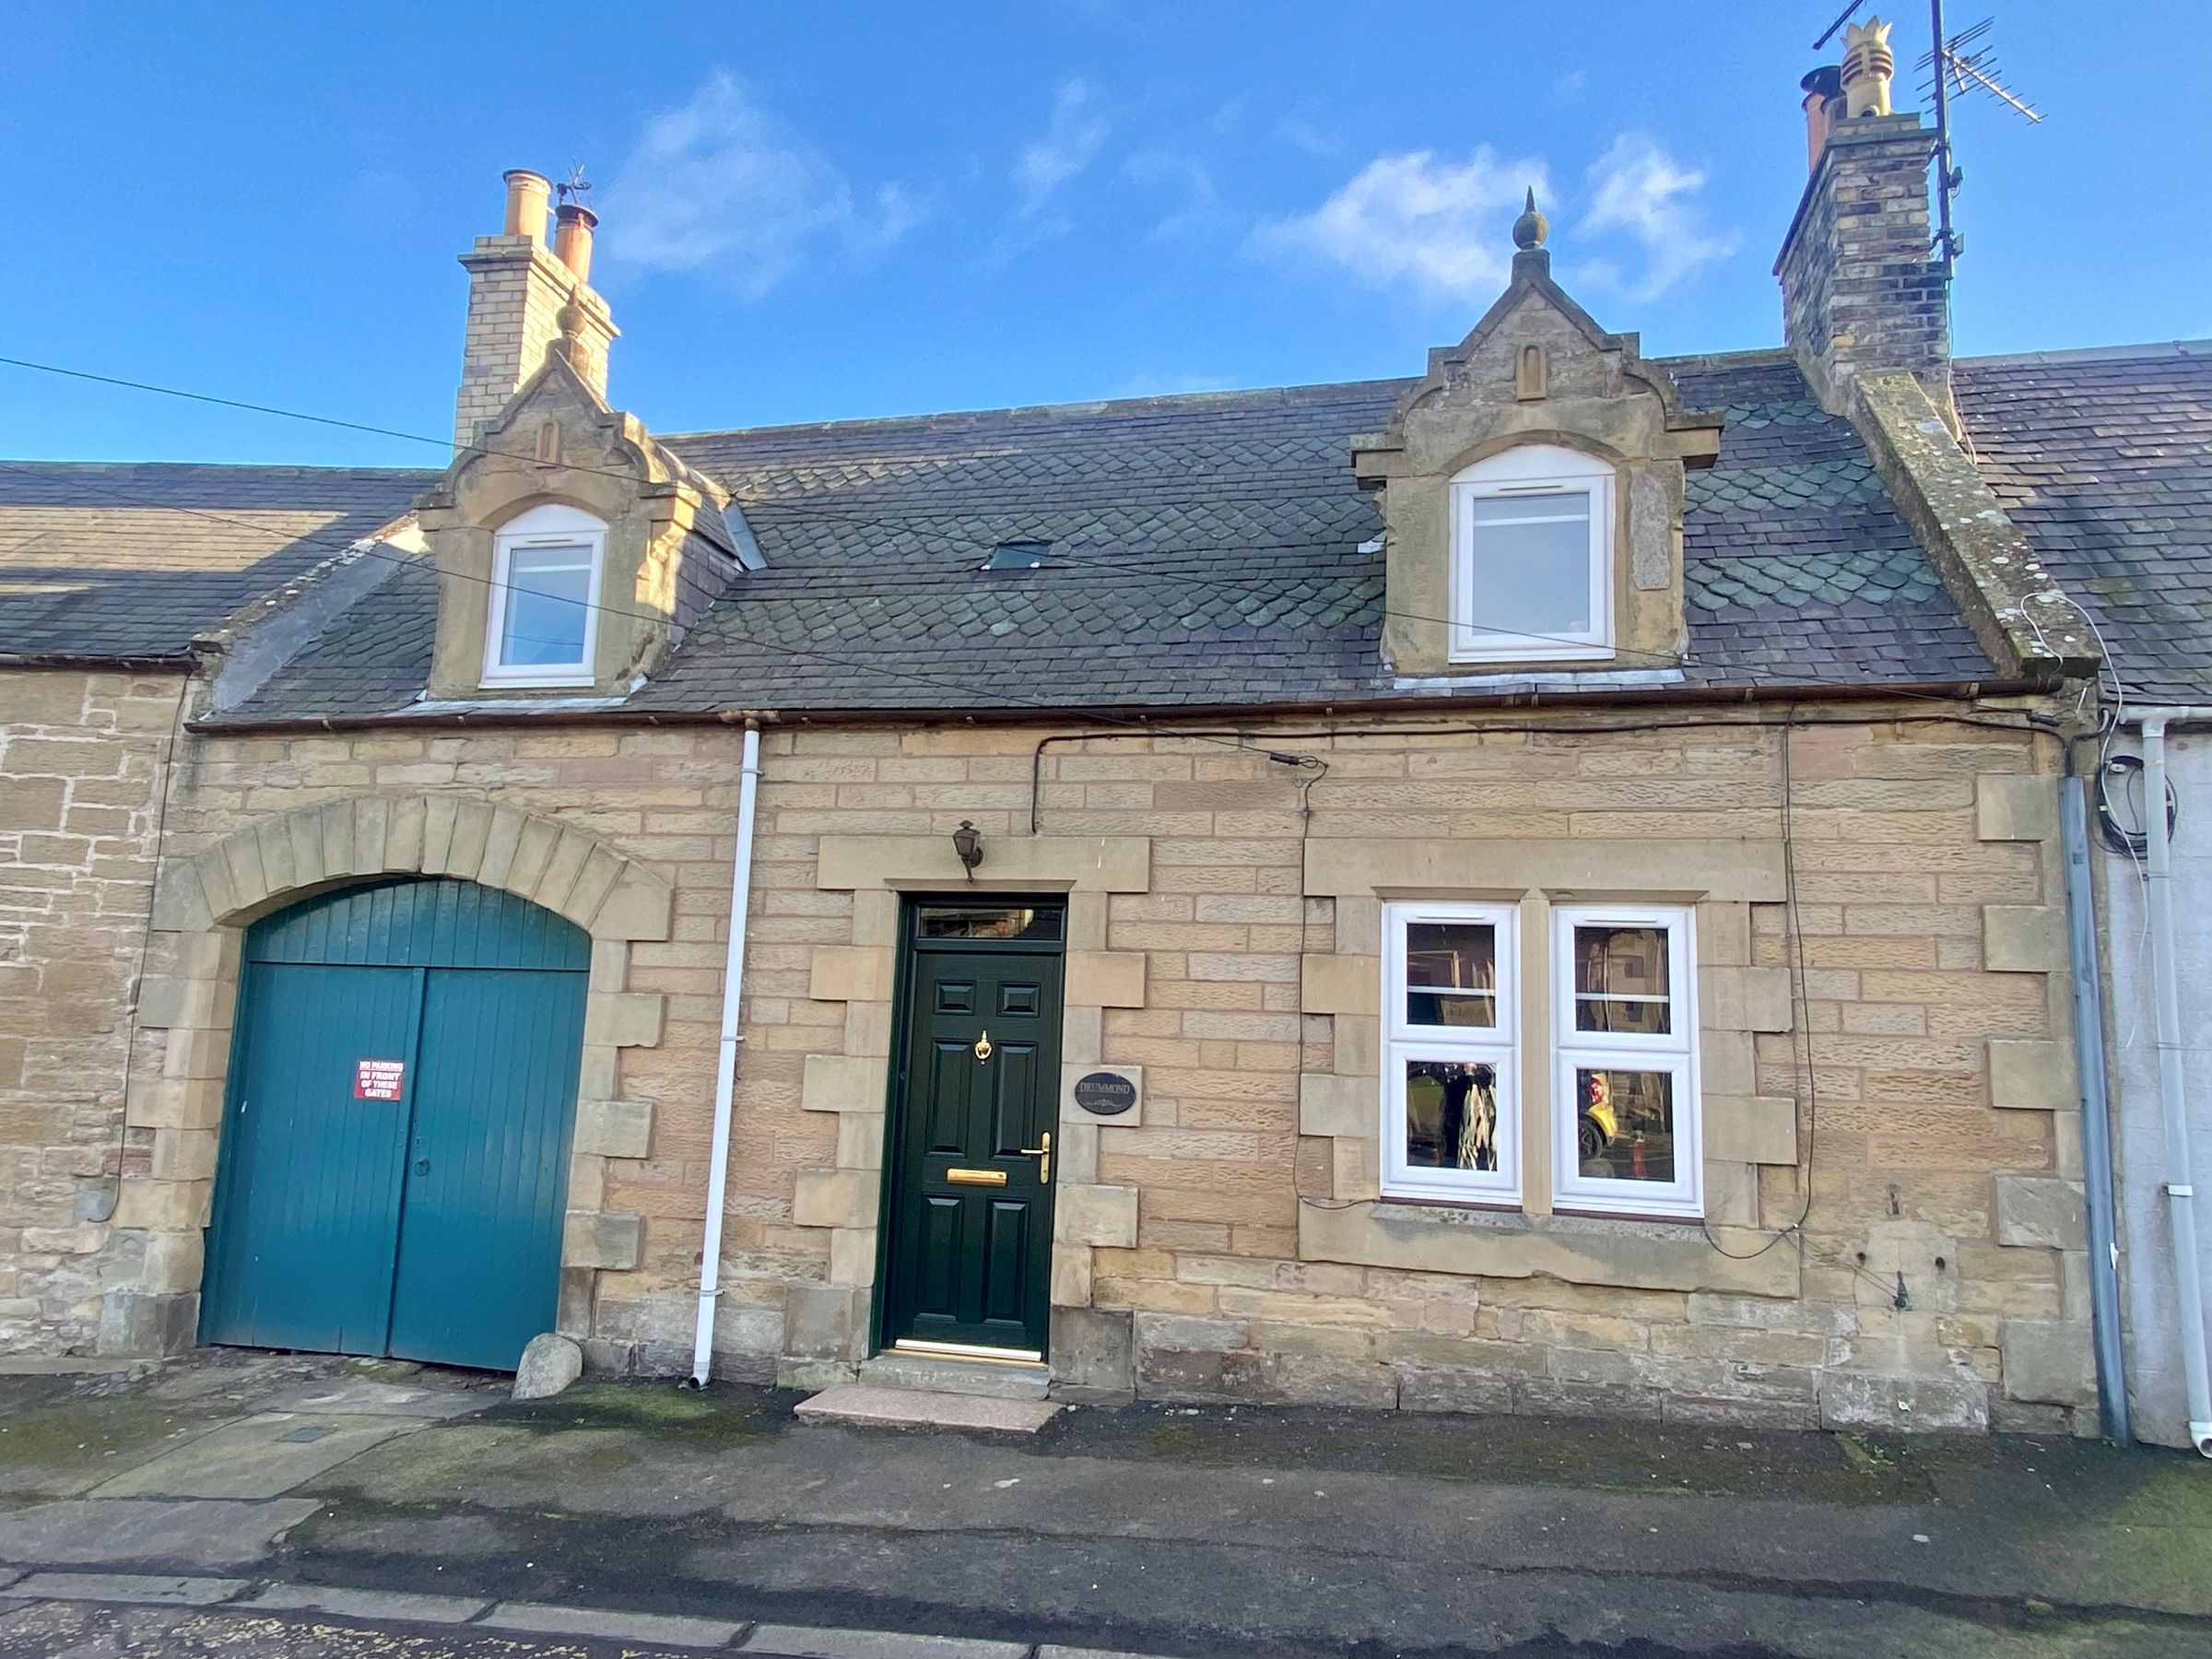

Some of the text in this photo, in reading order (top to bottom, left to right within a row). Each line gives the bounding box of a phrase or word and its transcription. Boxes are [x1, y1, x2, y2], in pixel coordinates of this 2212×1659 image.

[371, 1062, 404, 1072] PARKING
[371, 1072, 401, 1080] FRONT
[373, 1080, 397, 1089] THESE
[1080, 1082, 1130, 1094] DRUMMOND
[365, 1088, 392, 1098] GATES
